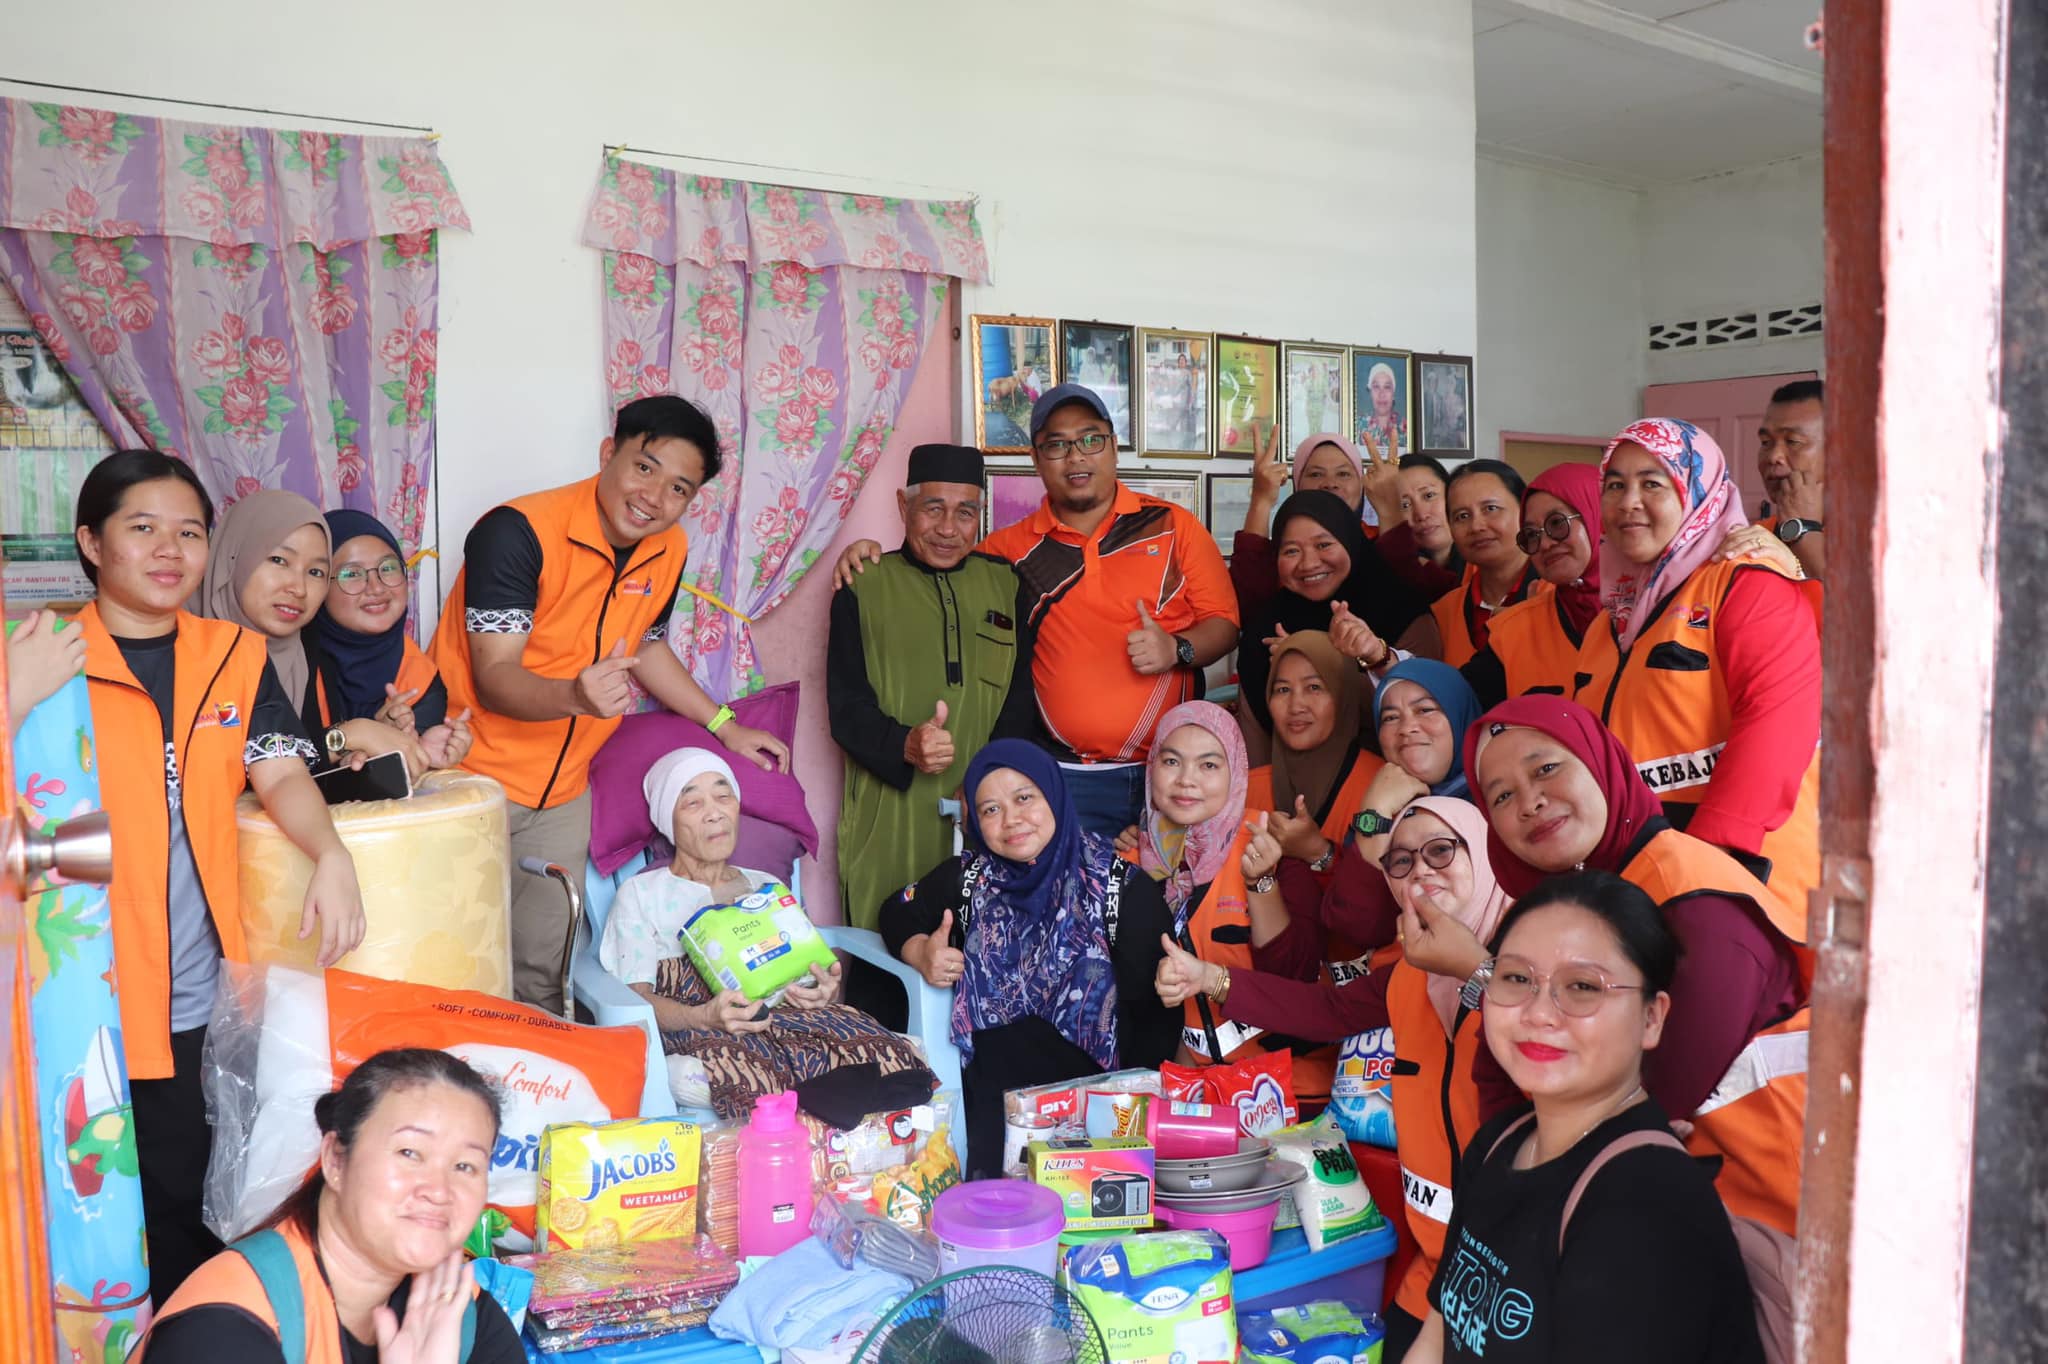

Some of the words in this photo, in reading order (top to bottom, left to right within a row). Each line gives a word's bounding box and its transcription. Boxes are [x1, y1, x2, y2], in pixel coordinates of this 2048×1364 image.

[732, 919, 761, 936] Pants
[438, 1003, 464, 1014] SOFT
[471, 1007, 521, 1023] COMFORT
[501, 1061, 571, 1105] Comfort
[624, 1190, 689, 1206] WEETAMEAL
[1108, 1325, 1154, 1340] Pants
